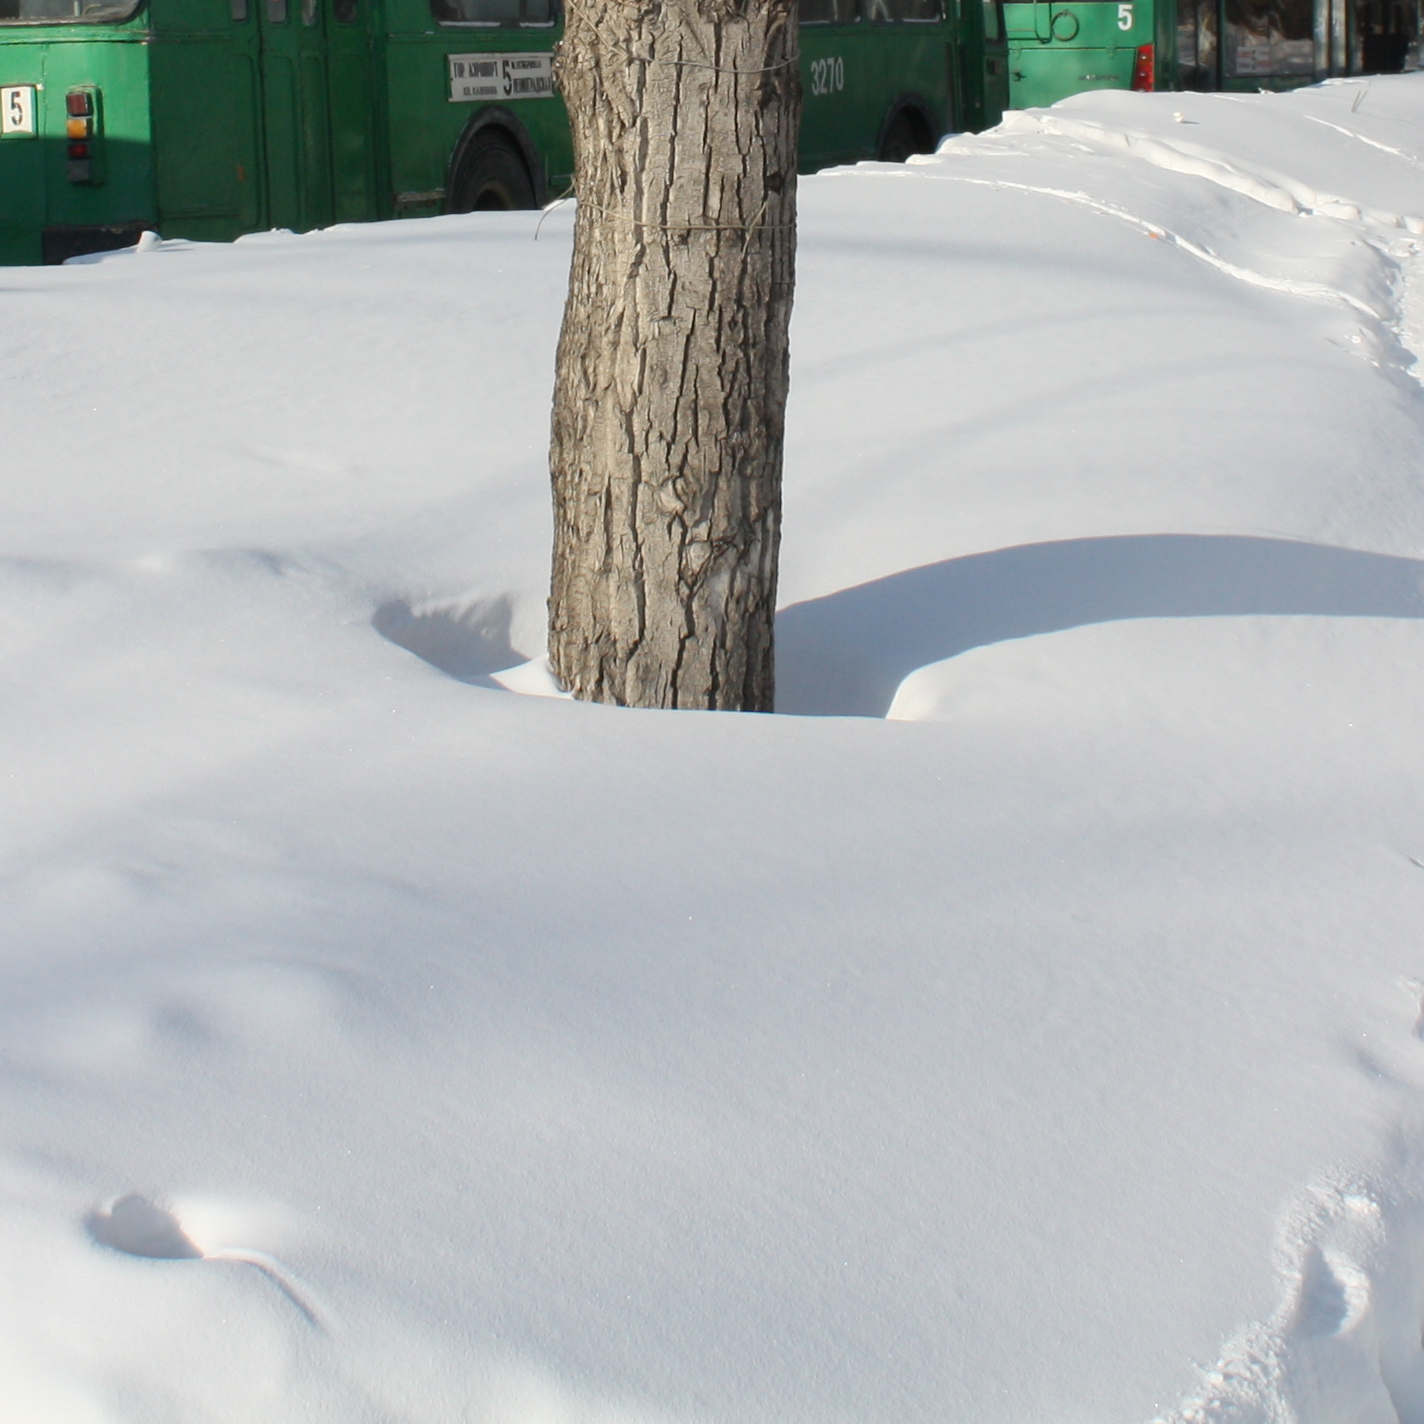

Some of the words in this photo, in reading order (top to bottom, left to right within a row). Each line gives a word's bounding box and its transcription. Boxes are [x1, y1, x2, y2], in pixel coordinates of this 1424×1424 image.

[1117, 4, 1133, 31] 5
[502, 60, 512, 96] 5
[811, 57, 843, 96] 3270
[10, 91, 24, 126] 5
